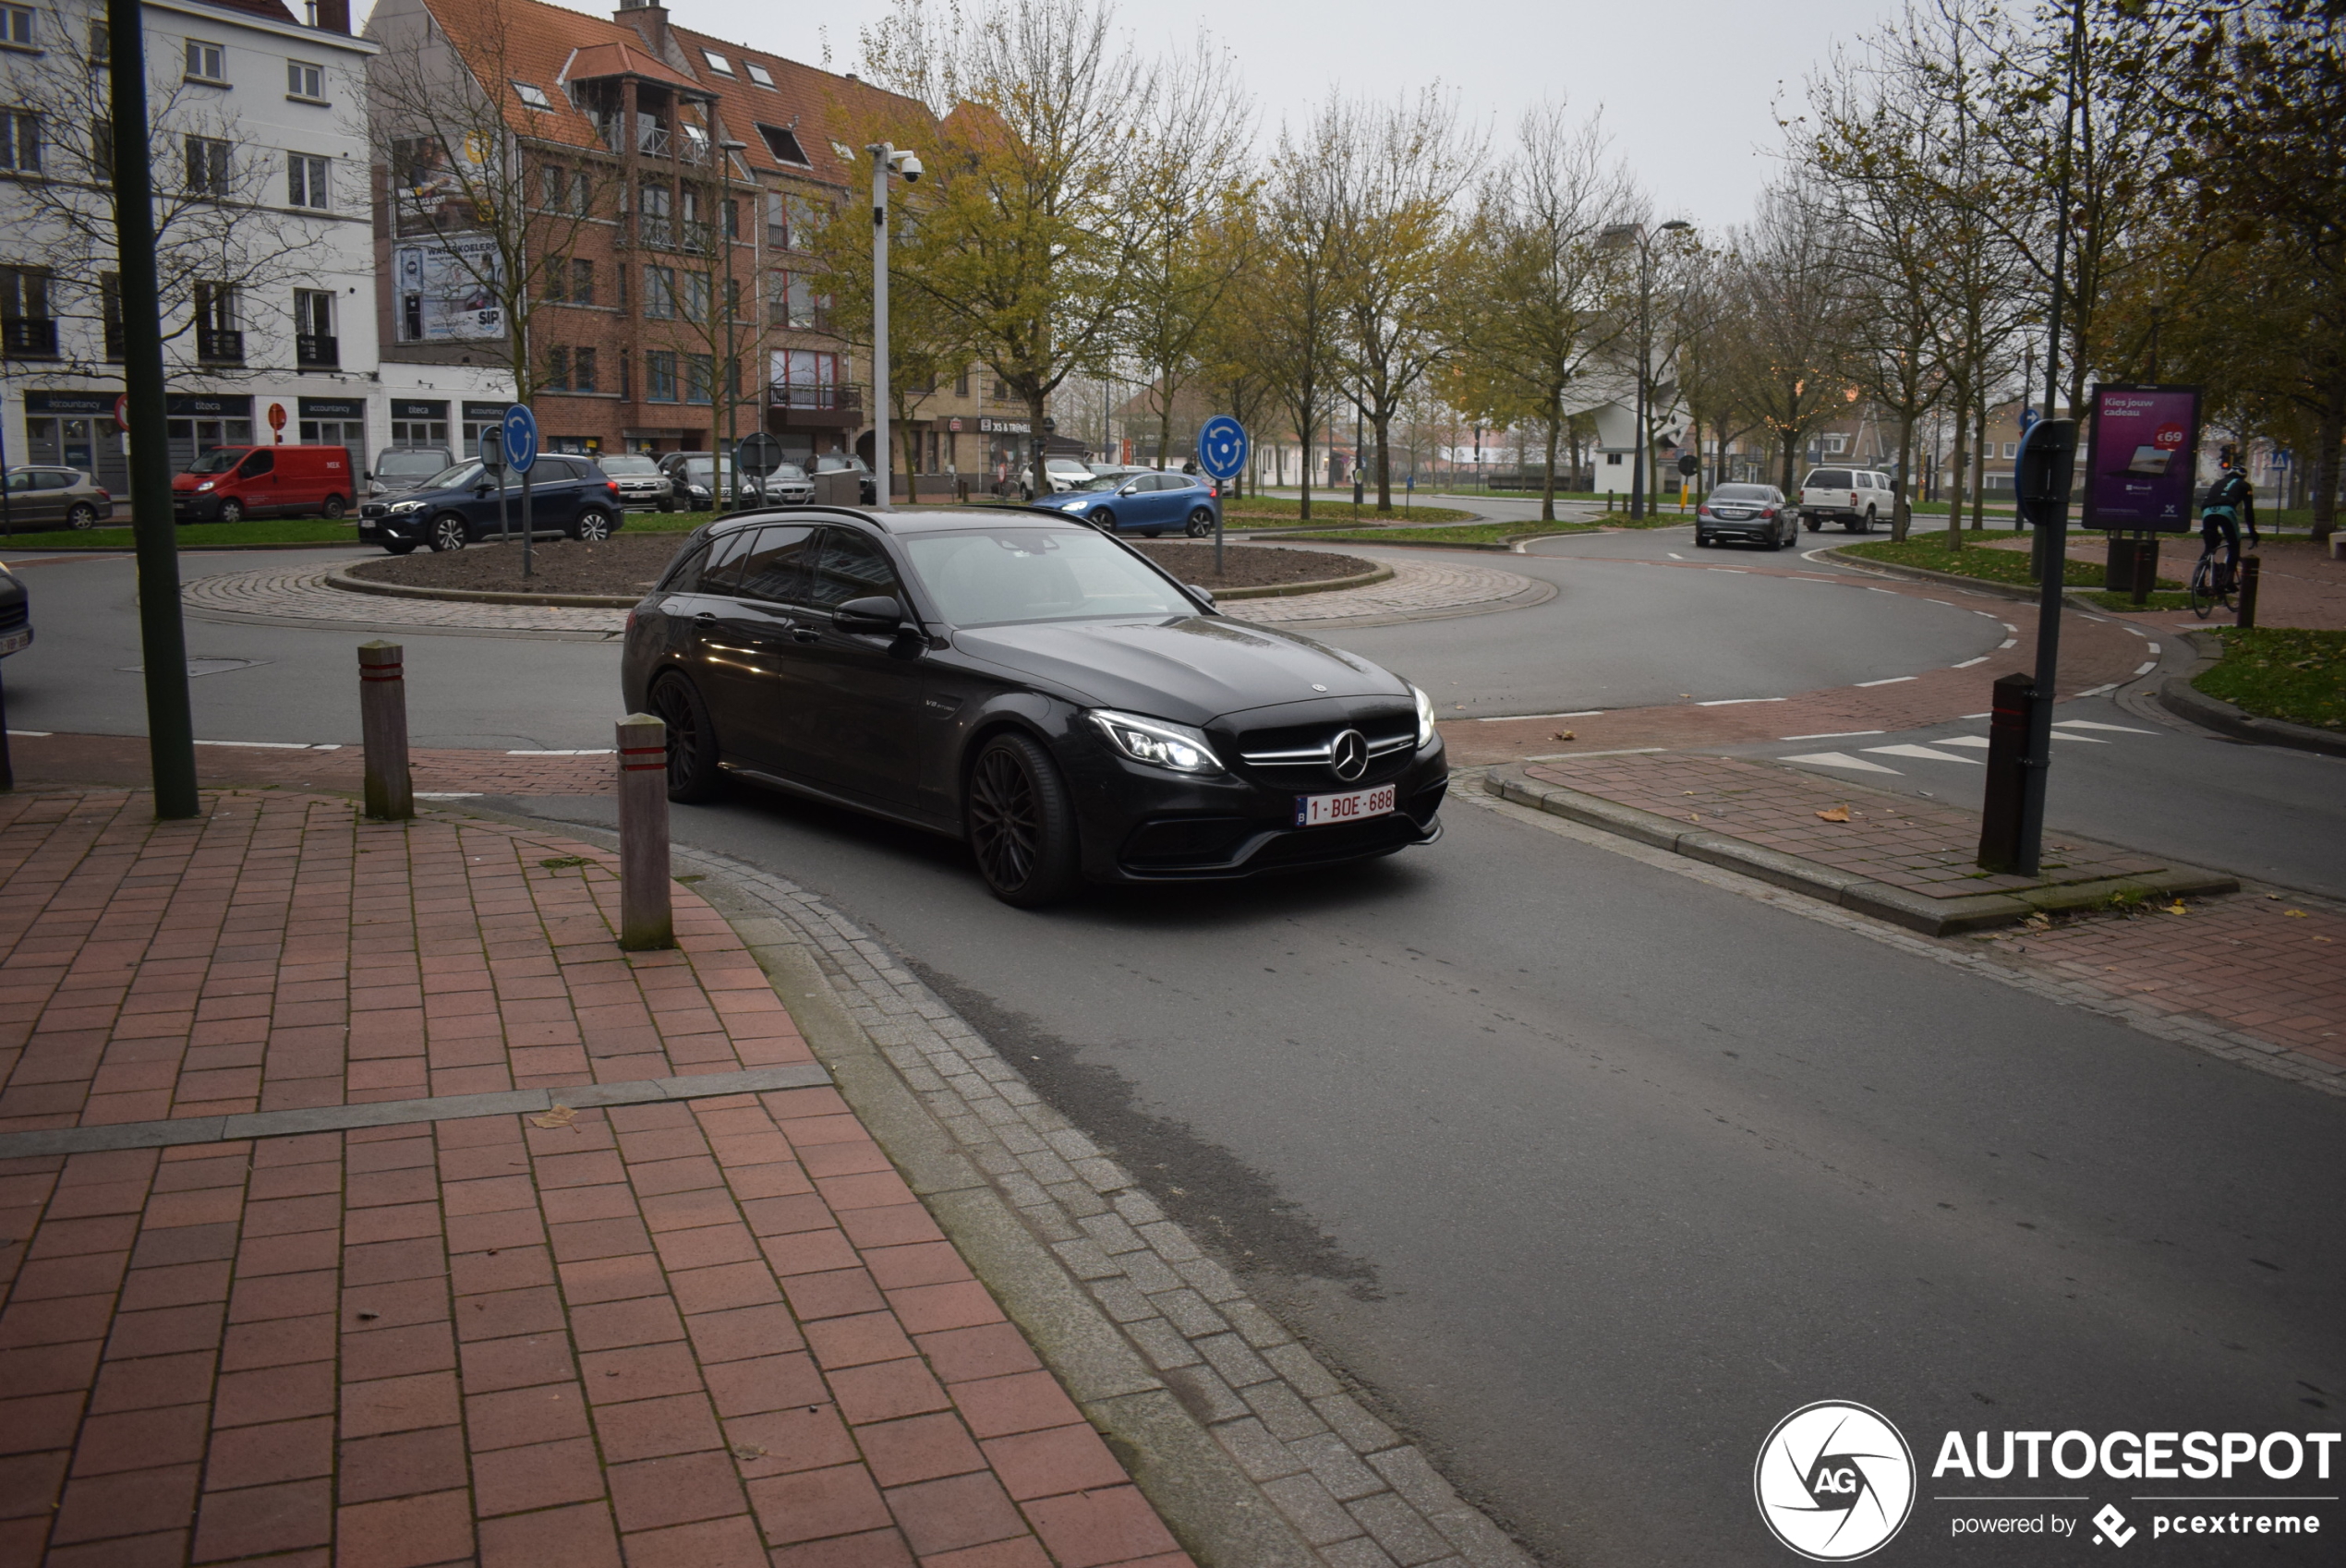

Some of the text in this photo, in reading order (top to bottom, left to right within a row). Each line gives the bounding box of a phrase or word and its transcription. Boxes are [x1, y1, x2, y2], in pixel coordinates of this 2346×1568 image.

[478, 310, 499, 325] SIP
[48, 399, 101, 411] accountancy
[195, 400, 221, 411] titeca
[2104, 398, 2154, 408] Kies jouw
[308, 404, 351, 415] accountancy
[408, 404, 429, 415] titeca
[470, 407, 504, 416] accountancy
[2104, 407, 2140, 416] cadeau
[2157, 431, 2183, 442] €69
[925, 699, 937, 707] V8
[1312, 790, 1393, 820] 1-BOE-688
[1298, 813, 1305, 823] B
